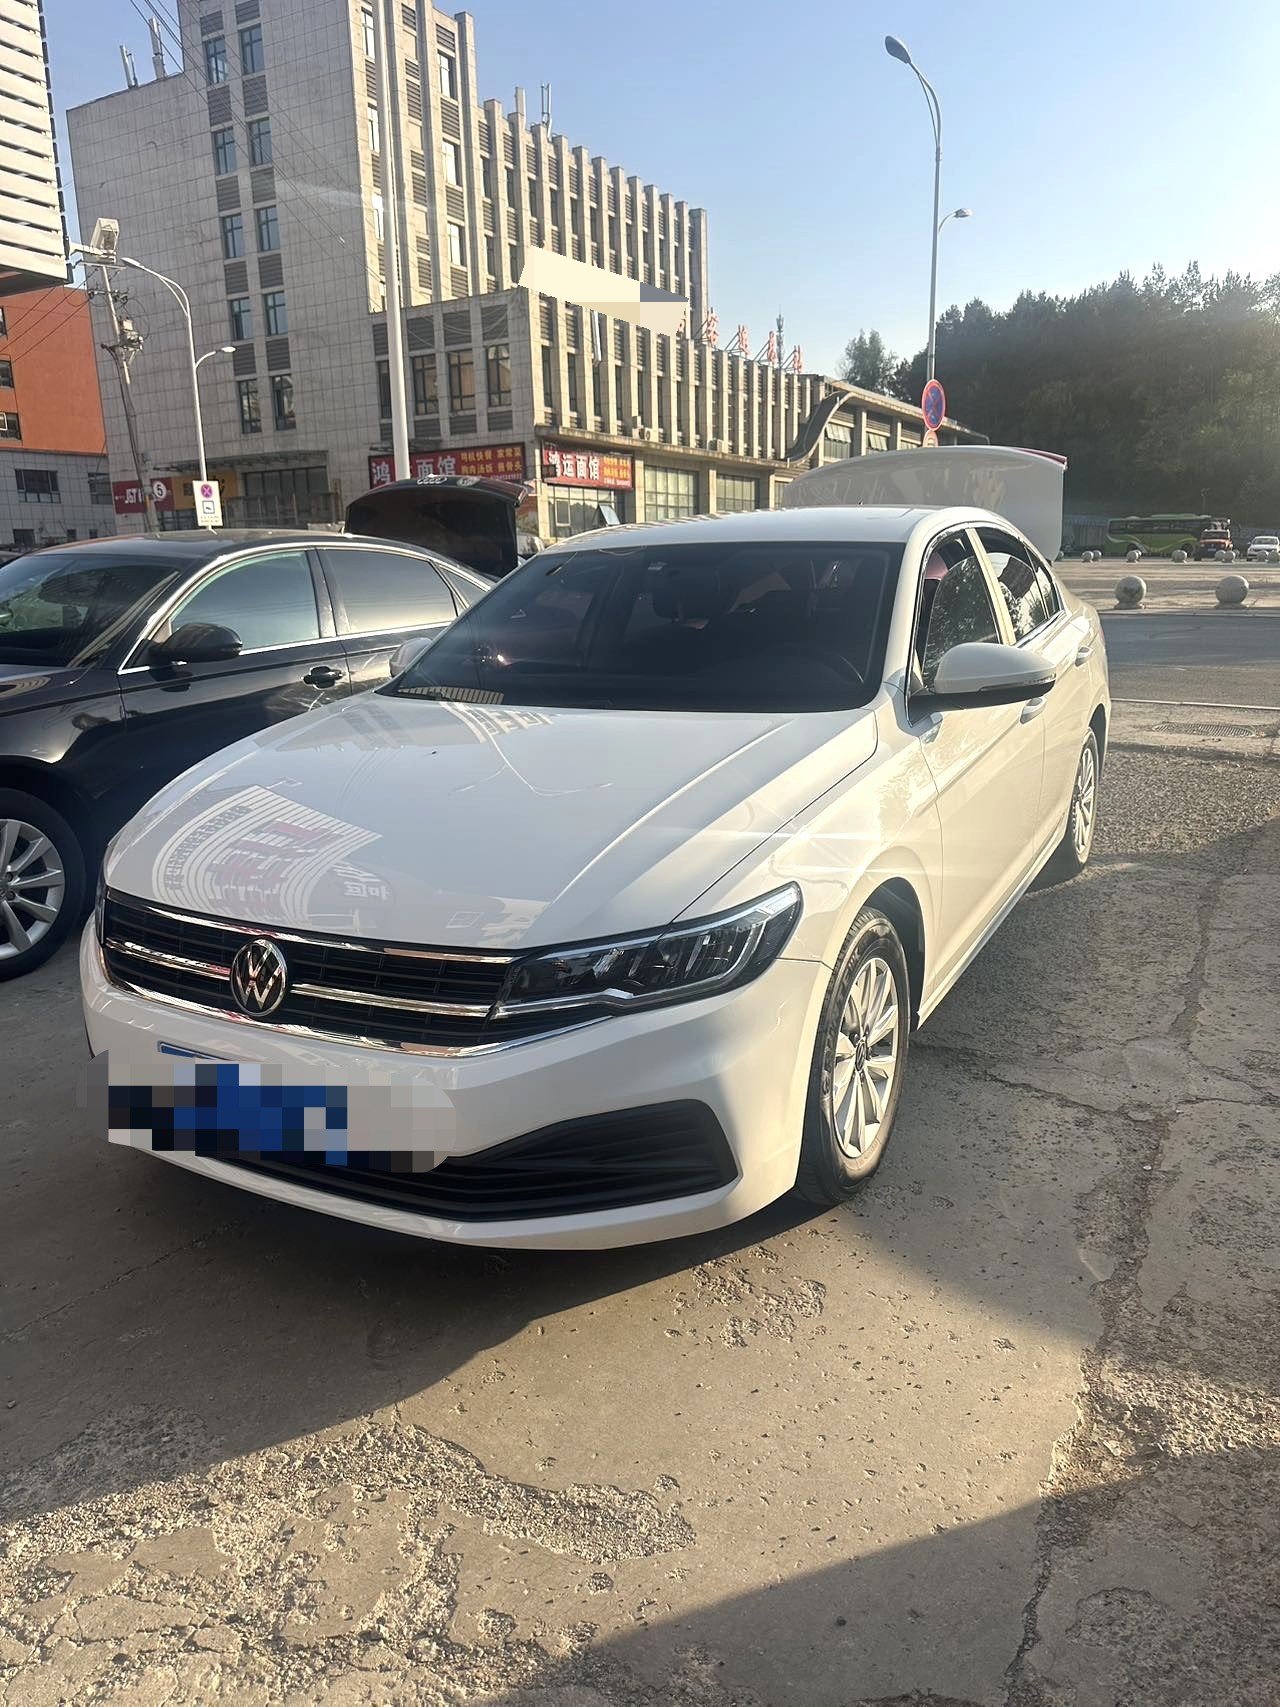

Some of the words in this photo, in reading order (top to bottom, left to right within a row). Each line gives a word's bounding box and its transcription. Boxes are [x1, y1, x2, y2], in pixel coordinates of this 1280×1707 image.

[371, 455, 456, 485] 鸿面馆
[548, 450, 600, 480] 鸿运面馆
